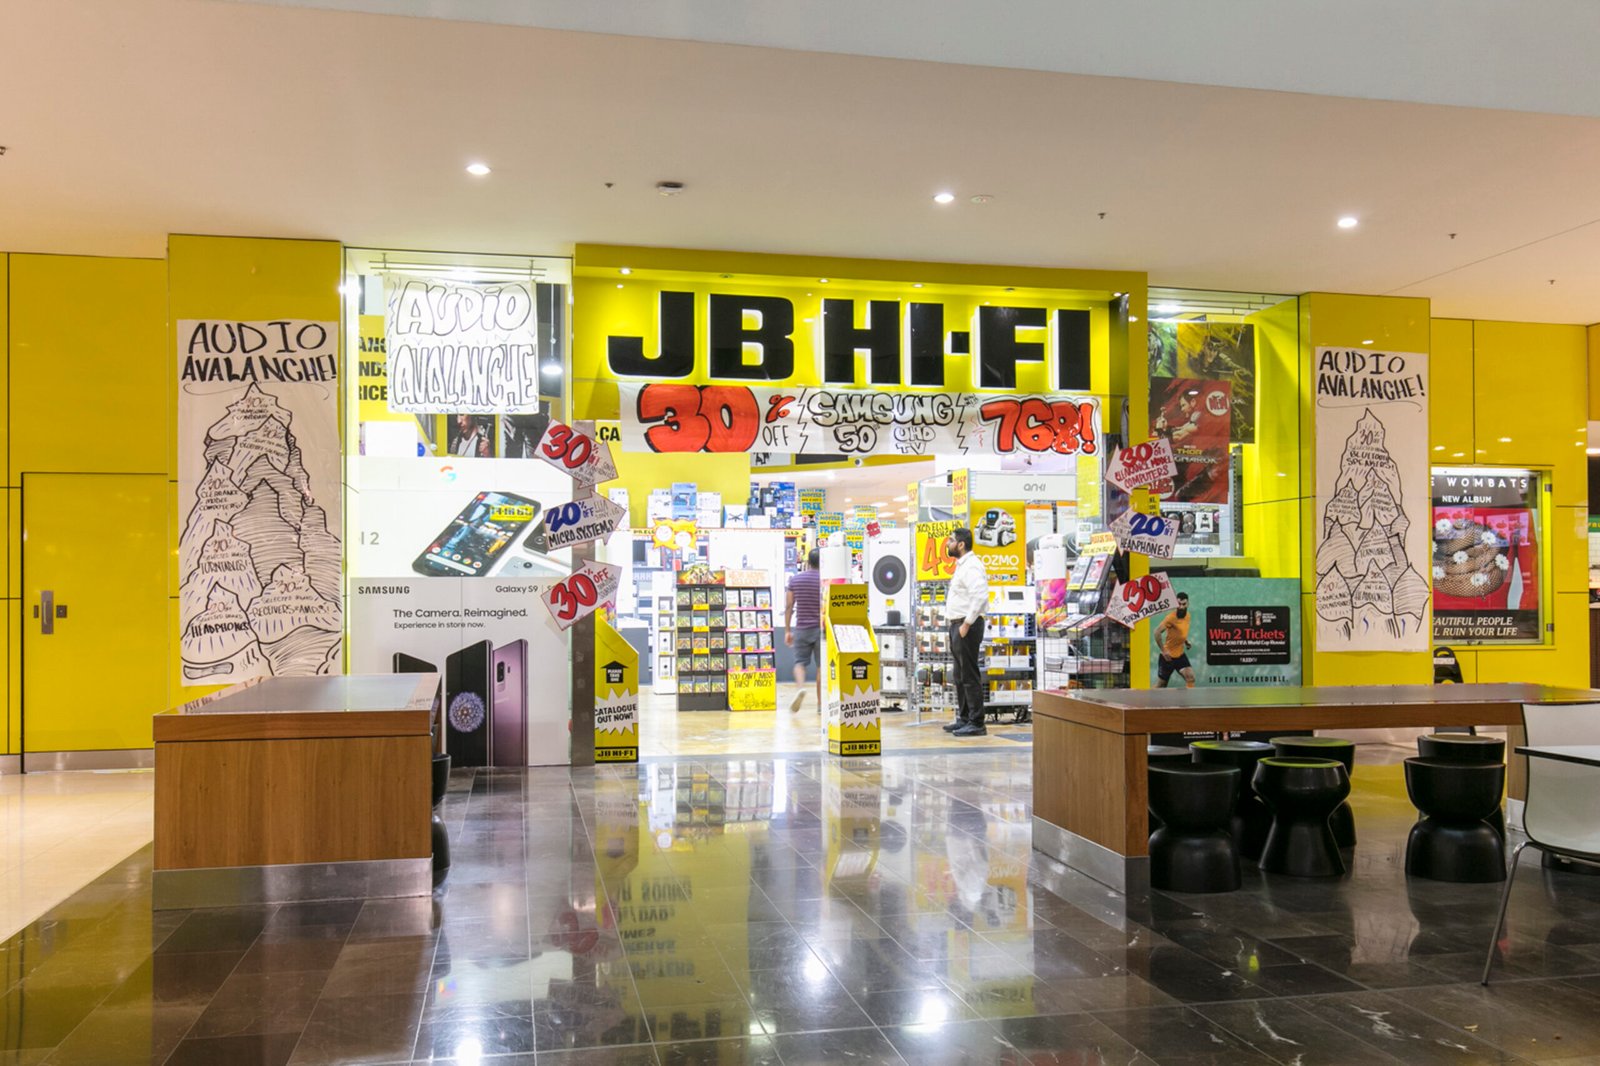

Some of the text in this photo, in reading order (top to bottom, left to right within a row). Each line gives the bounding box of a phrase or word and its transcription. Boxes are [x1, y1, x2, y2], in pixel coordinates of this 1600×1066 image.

[396, 281, 532, 336] AUDIO
[188, 322, 327, 354] AUDIO
[607, 290, 1091, 392] JB HI-FI
[181, 354, 337, 382] AVALANCHE!
[1319, 350, 1405, 375] AUDIO
[393, 344, 537, 406] AVALANCHE
[1318, 373, 1425, 400] AVALANCHE!
[807, 391, 954, 426] SAMSUNG
[762, 424, 789, 447] OFF
[894, 426, 936, 442] UHD
[896, 441, 926, 455] TV
[1124, 464, 1169, 488] COMPUTERS
[1446, 476, 1528, 489] WOMBATS
[1462, 495, 1492, 503] ALBUM
[370, 531, 379, 545] 2
[548, 519, 614, 547] MICRO SYSTEMS
[1120, 538, 1171, 558] HEADPHONES
[593, 567, 609, 583] OFF
[358, 586, 410, 595] SAMSUNG
[495, 585, 526, 594] Galaxy
[393, 608, 528, 619] The Camera. Reimagined.
[1477, 617, 1513, 626] PEOPLE
[191, 620, 250, 638] HEADPHONES
[394, 622, 436, 630] Experience
[1209, 628, 1285, 640] Win 2 Tickets
[1442, 627, 1466, 636] RUIN
[1469, 627, 1494, 636] YOUR
[1497, 627, 1518, 636] LIFE
[840, 699, 880, 711] CATALOGUE
[844, 708, 877, 718] OUT NOW!
[597, 712, 634, 724] OUT NOW!
